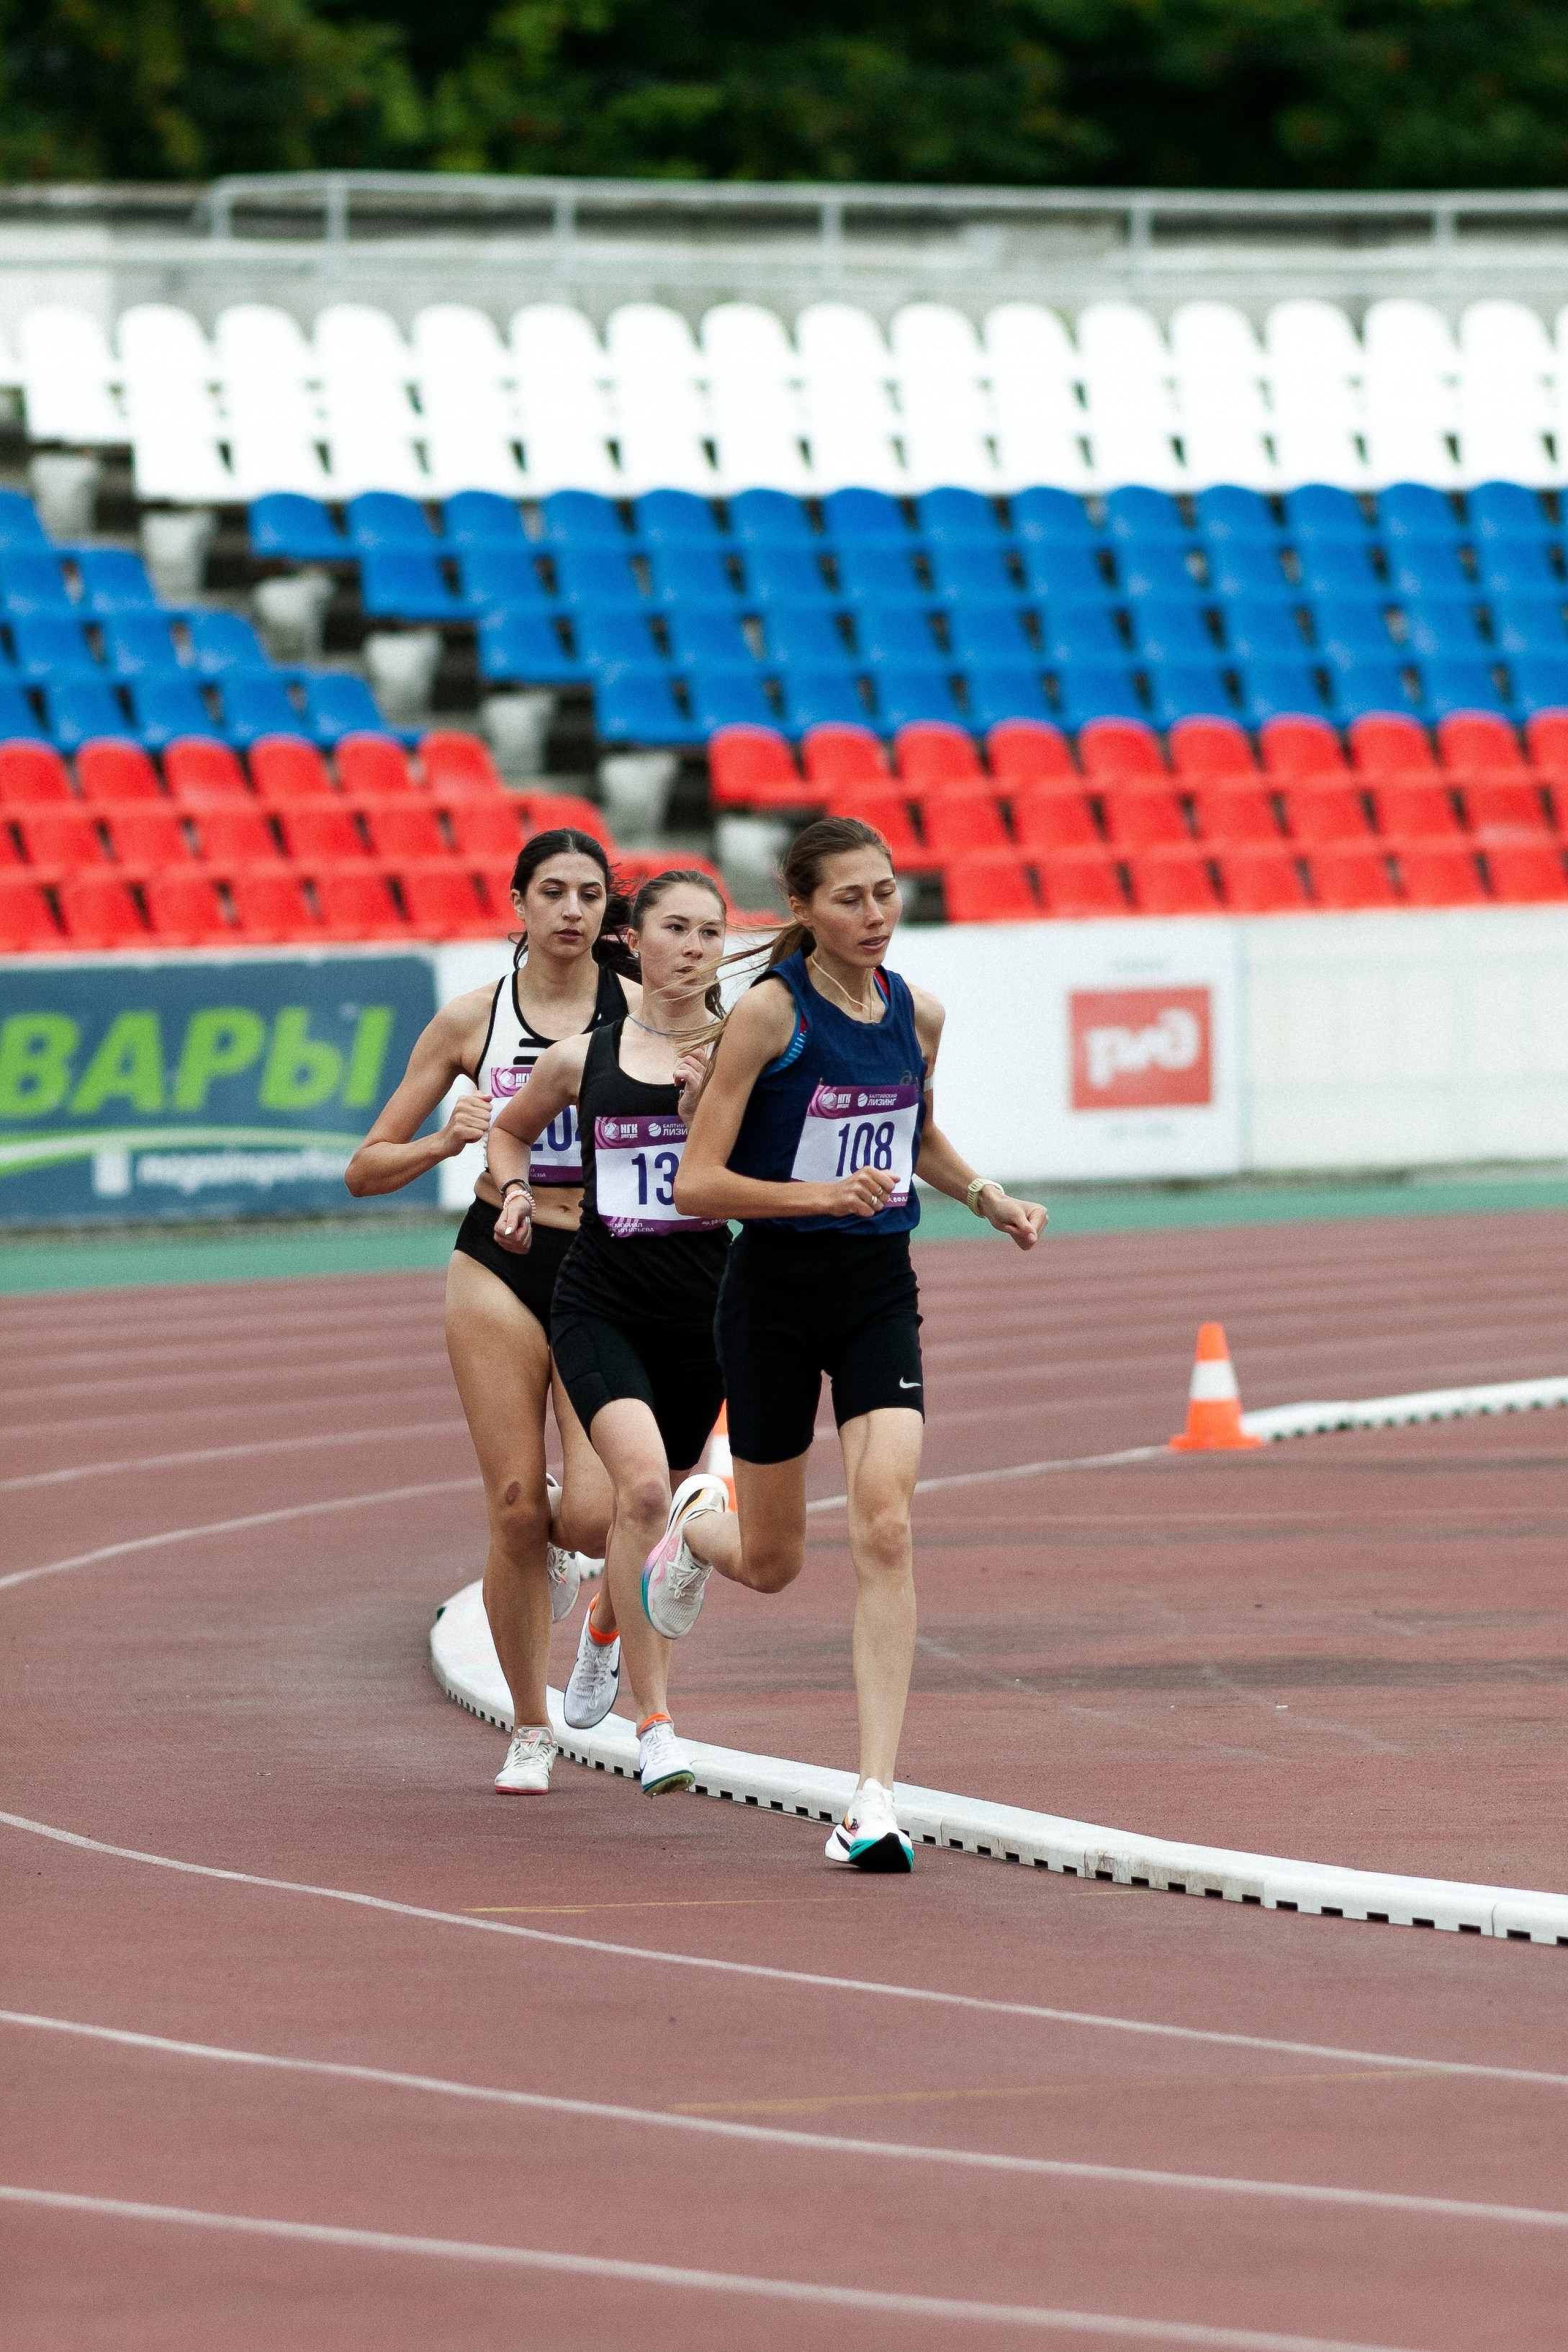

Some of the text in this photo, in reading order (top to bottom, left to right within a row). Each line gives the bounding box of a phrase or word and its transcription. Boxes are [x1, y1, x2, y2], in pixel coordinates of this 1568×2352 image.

[620, 1123, 638, 1133] НГК
[662, 1127, 688, 1136] ЛИЗИ
[836, 1121, 895, 1176] 108
